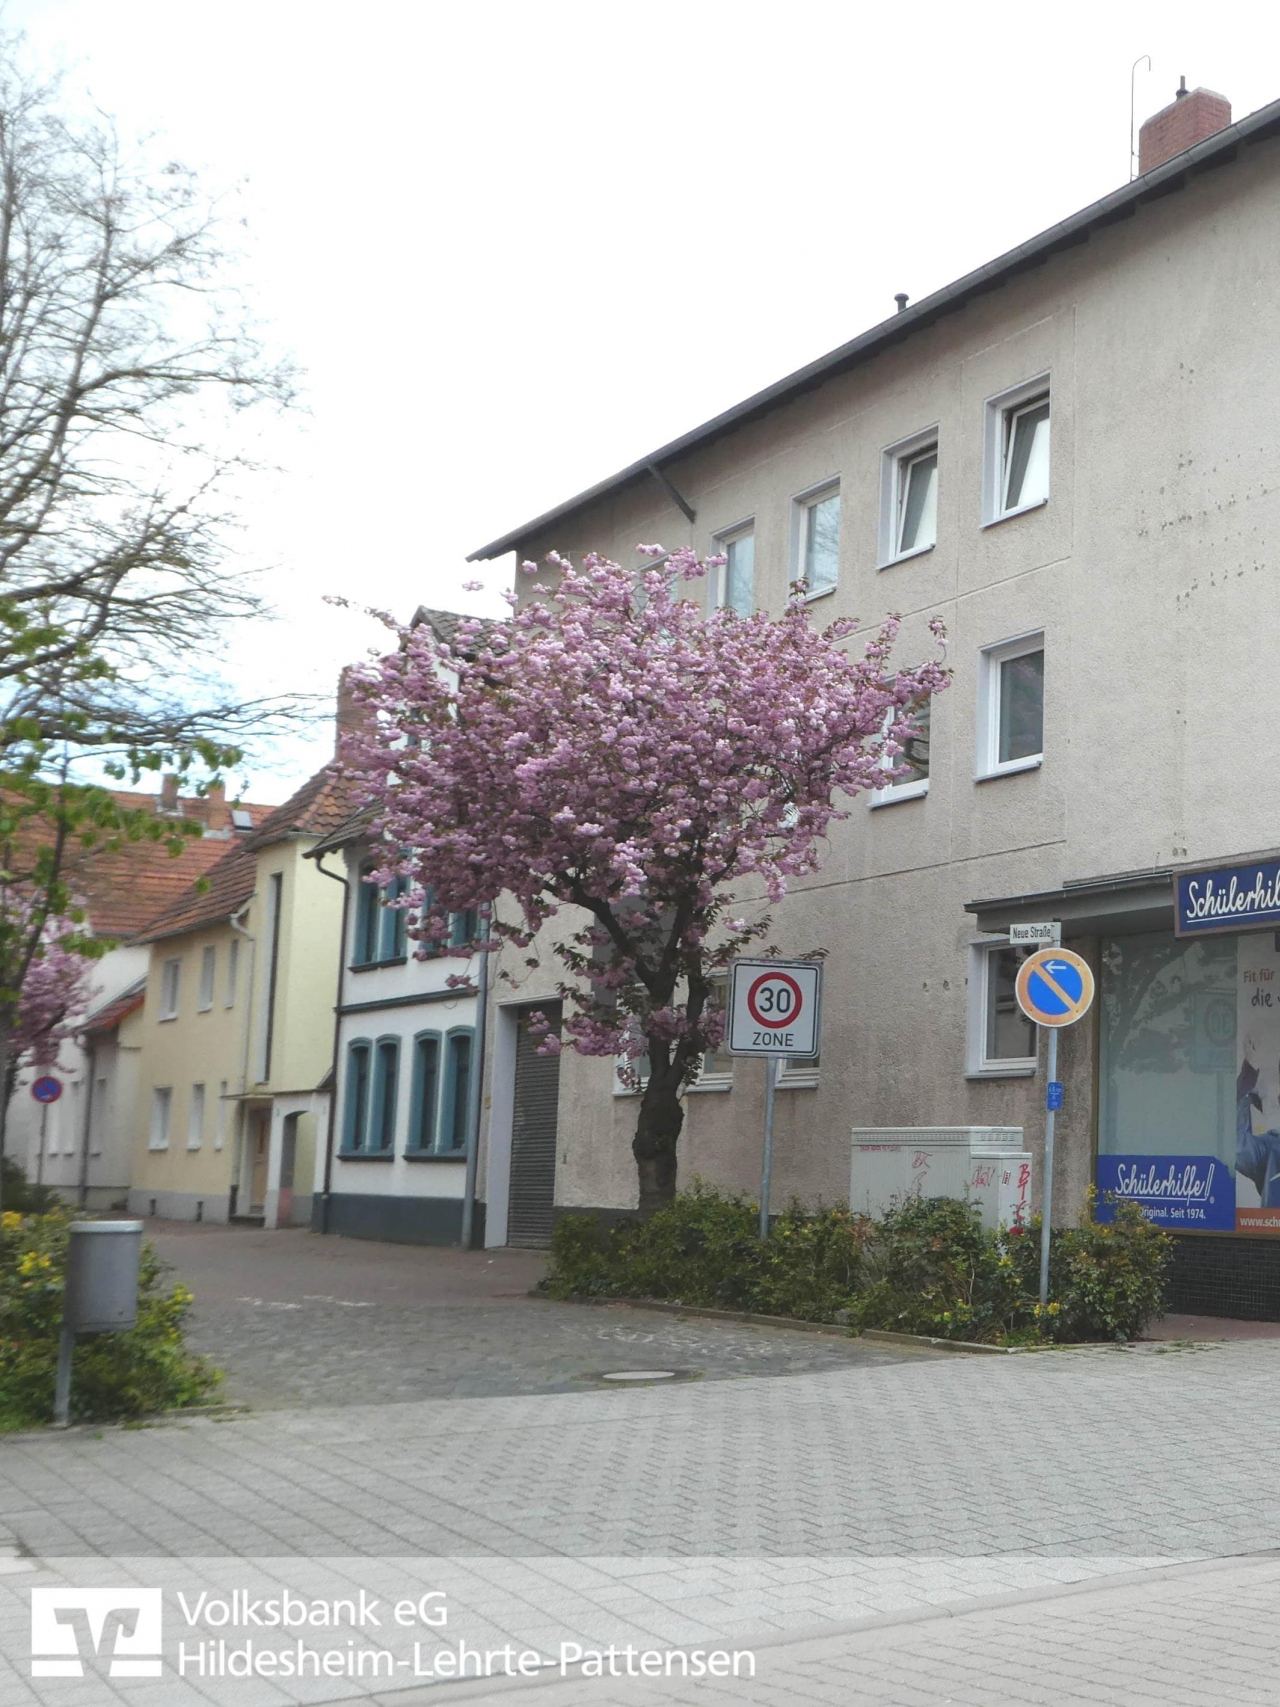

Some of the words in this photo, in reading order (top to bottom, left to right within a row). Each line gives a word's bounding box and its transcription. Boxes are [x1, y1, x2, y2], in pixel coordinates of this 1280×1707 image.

[1012, 927, 1029, 939] Neue
[1030, 925, 1051, 938] Straße
[1243, 970, 1257, 983] Fit
[1260, 968, 1275, 982] für
[759, 987, 791, 1013] 30
[1251, 987, 1273, 1007] die
[752, 1032, 794, 1047] ZONE
[1170, 1207, 1185, 1219] Seit
[1187, 1208, 1206, 1219] 1974.
